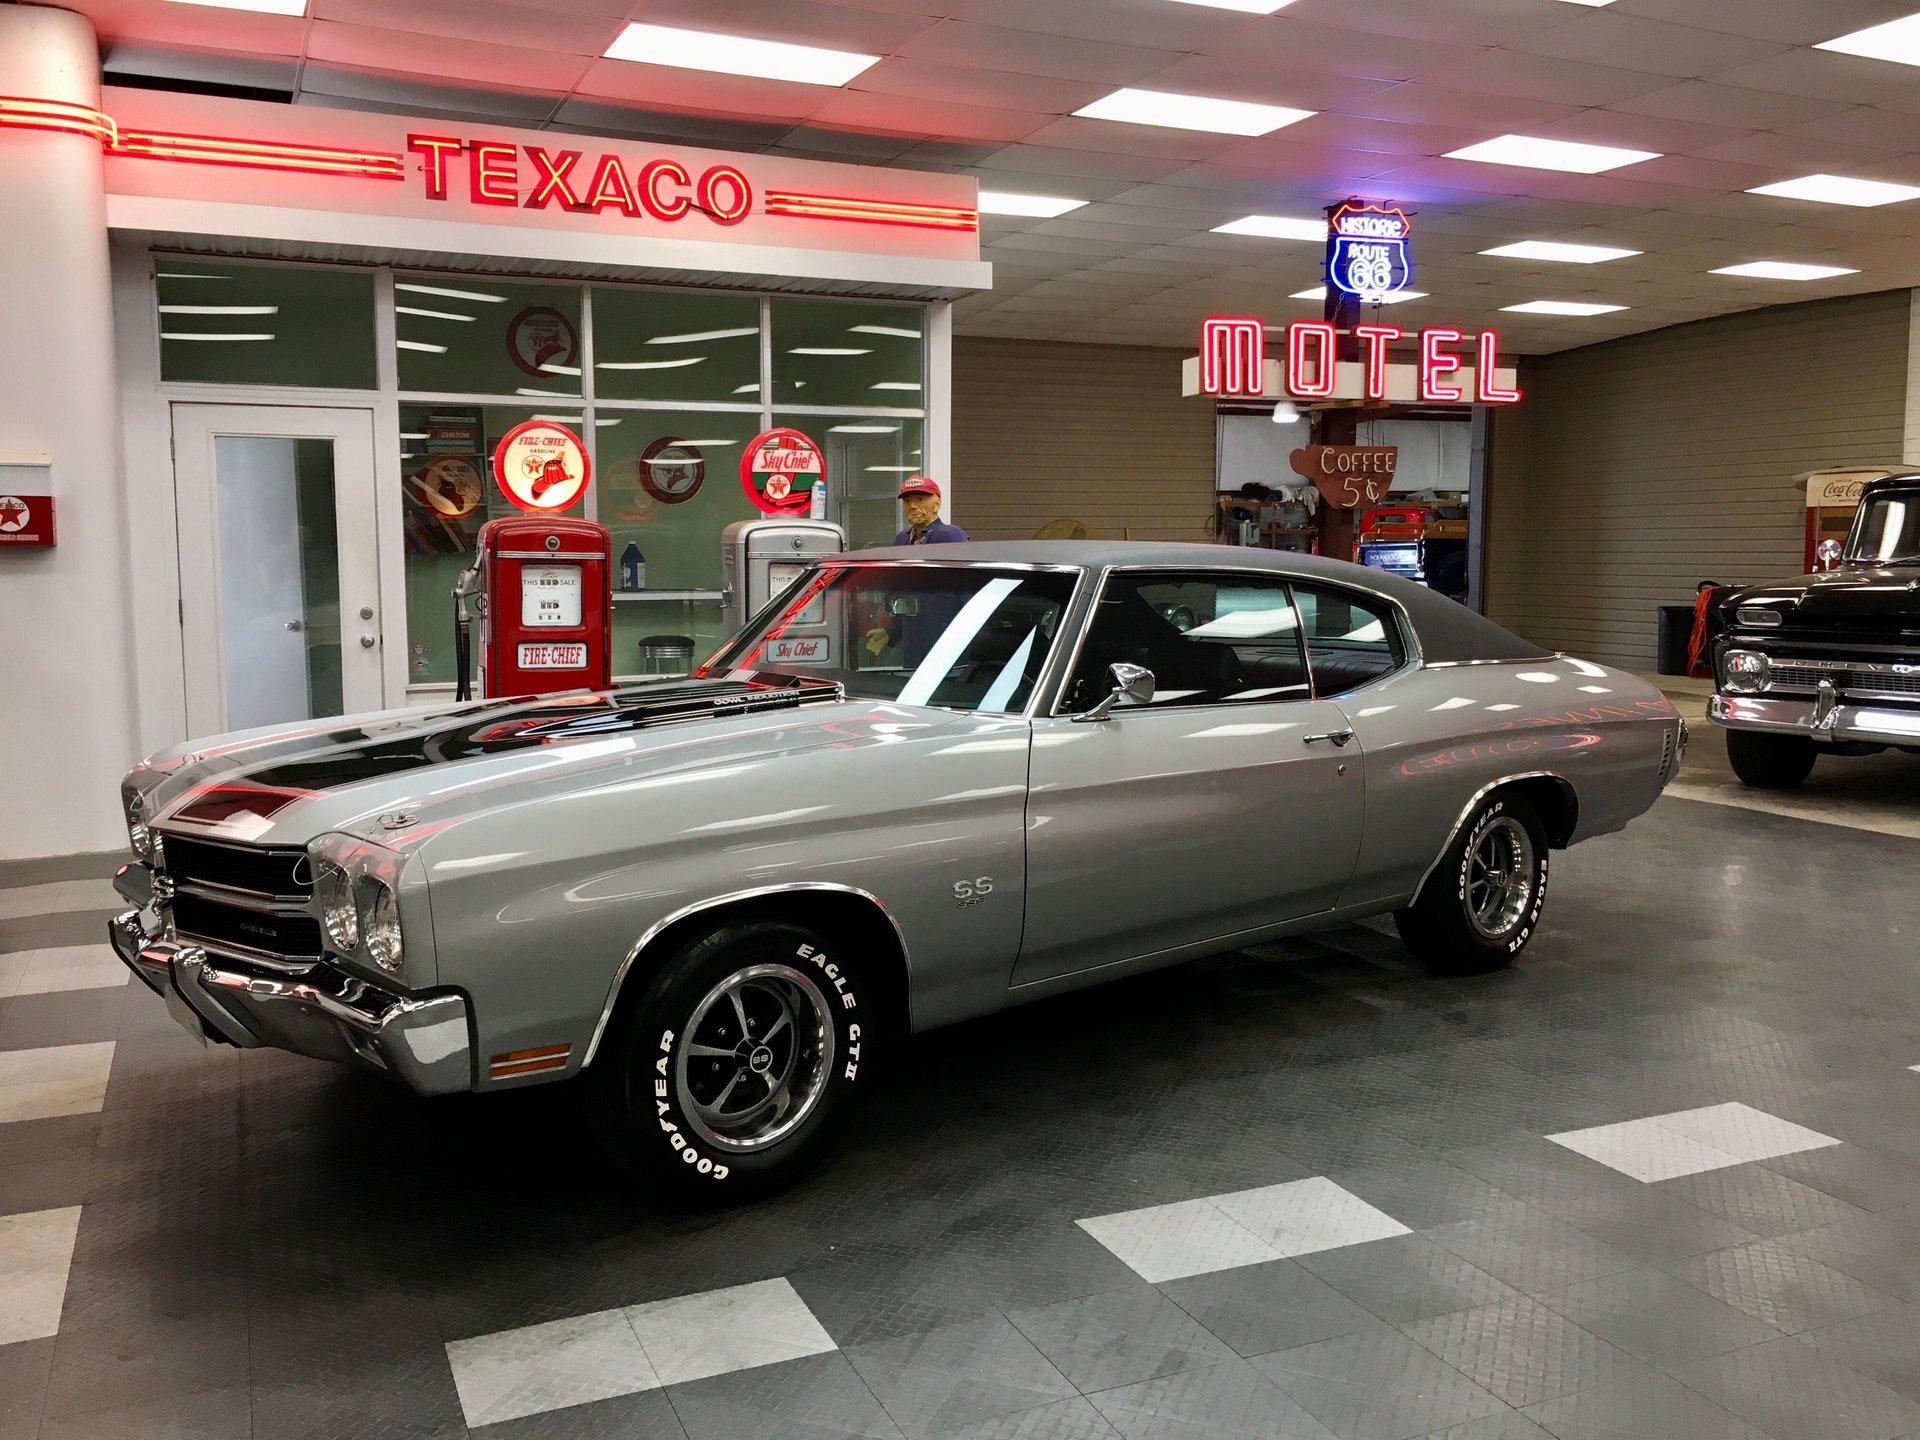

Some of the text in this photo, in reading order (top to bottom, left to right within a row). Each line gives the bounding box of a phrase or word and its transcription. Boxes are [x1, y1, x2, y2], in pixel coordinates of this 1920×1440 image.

[407, 133, 753, 226] TEXACO
[1340, 216, 1402, 237] HISTORIC
[1348, 243, 1389, 260] ROUTE
[1348, 259, 1392, 291] 66
[1199, 317, 1523, 403] MOTEL
[518, 436, 568, 447] FIRE-CHIEF
[760, 450, 813, 472] Sky Chief
[1321, 447, 1394, 474] COFFEE
[1343, 477, 1380, 507] 5¢
[523, 647, 582, 665] FIRE-CHIEF
[776, 641, 818, 658] Sky Chief
[747, 690, 800, 701] INDUCTION
[1459, 802, 1503, 900] GOODYEAR
[953, 876, 993, 899] SS
[1530, 860, 1548, 923] EAGLE
[796, 943, 857, 1010] EAGLE
[752, 1054, 769, 1064] SS
[655, 1029, 729, 1180] GOODYEAR
